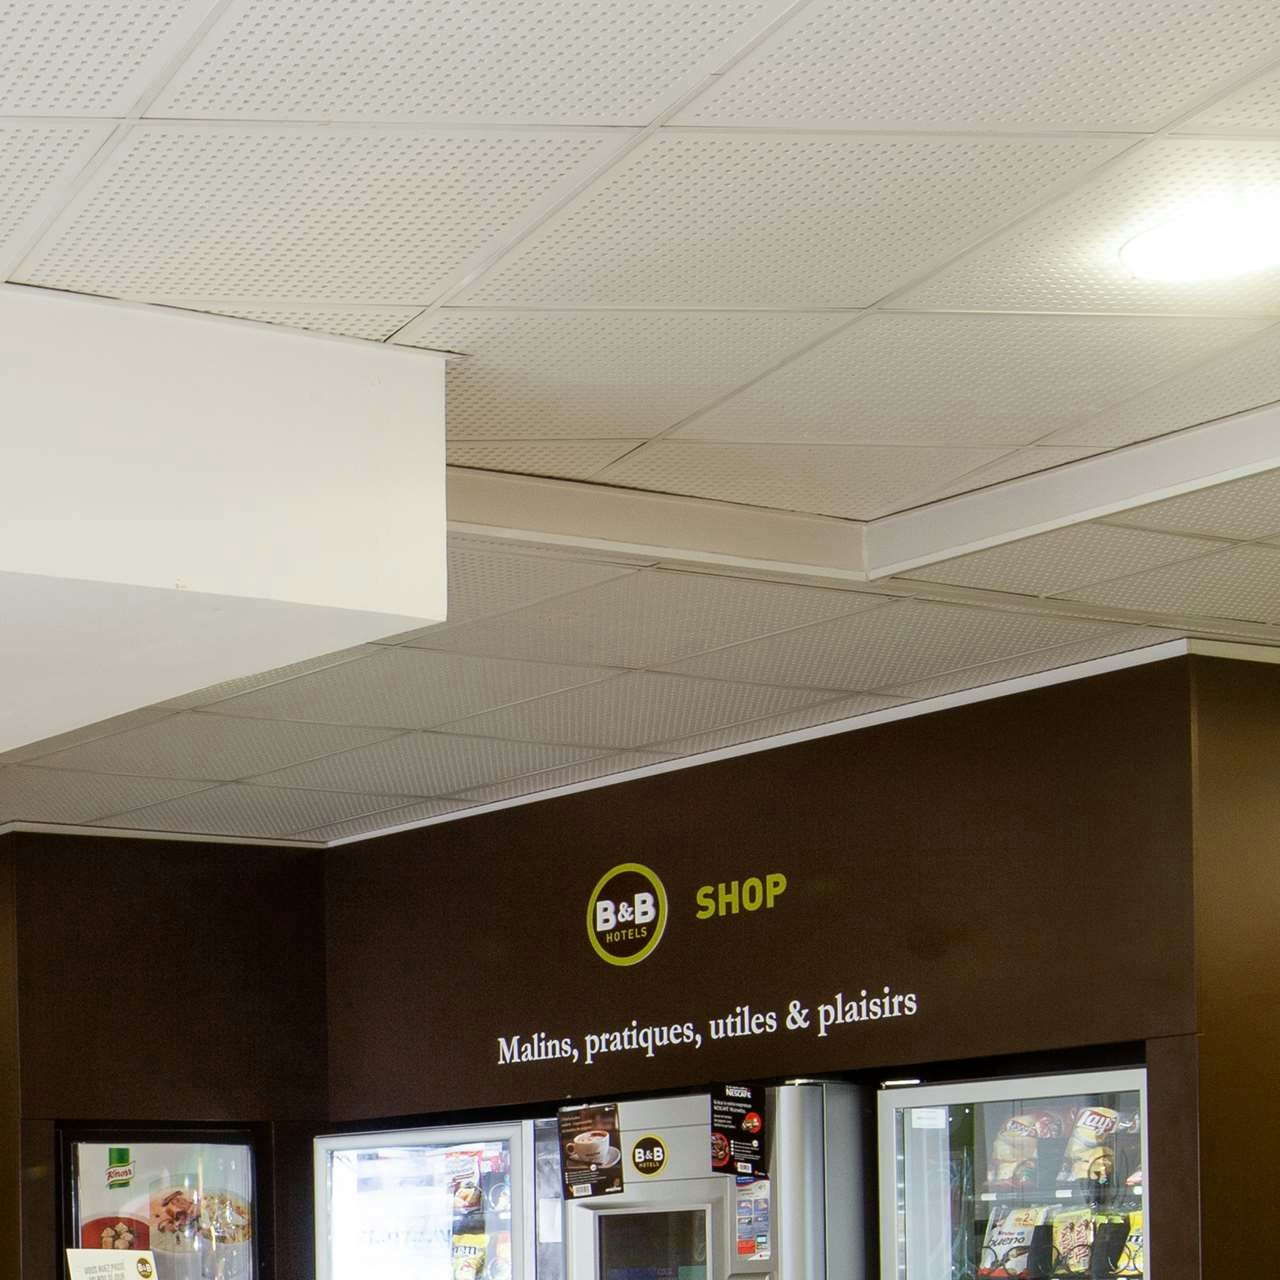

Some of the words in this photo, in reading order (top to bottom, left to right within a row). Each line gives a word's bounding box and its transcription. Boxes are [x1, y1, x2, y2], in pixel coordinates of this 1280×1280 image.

[595, 891, 656, 932] B&B
[695, 873, 787, 920] SHOP
[605, 926, 648, 943] HOTELS
[497, 1034, 579, 1065] Malins,
[584, 1019, 702, 1064] pratiques,
[710, 1004, 777, 1041] utiles
[786, 999, 809, 1030] &
[818, 986, 918, 1036] plaisirs
[634, 1147, 664, 1163] B&B
